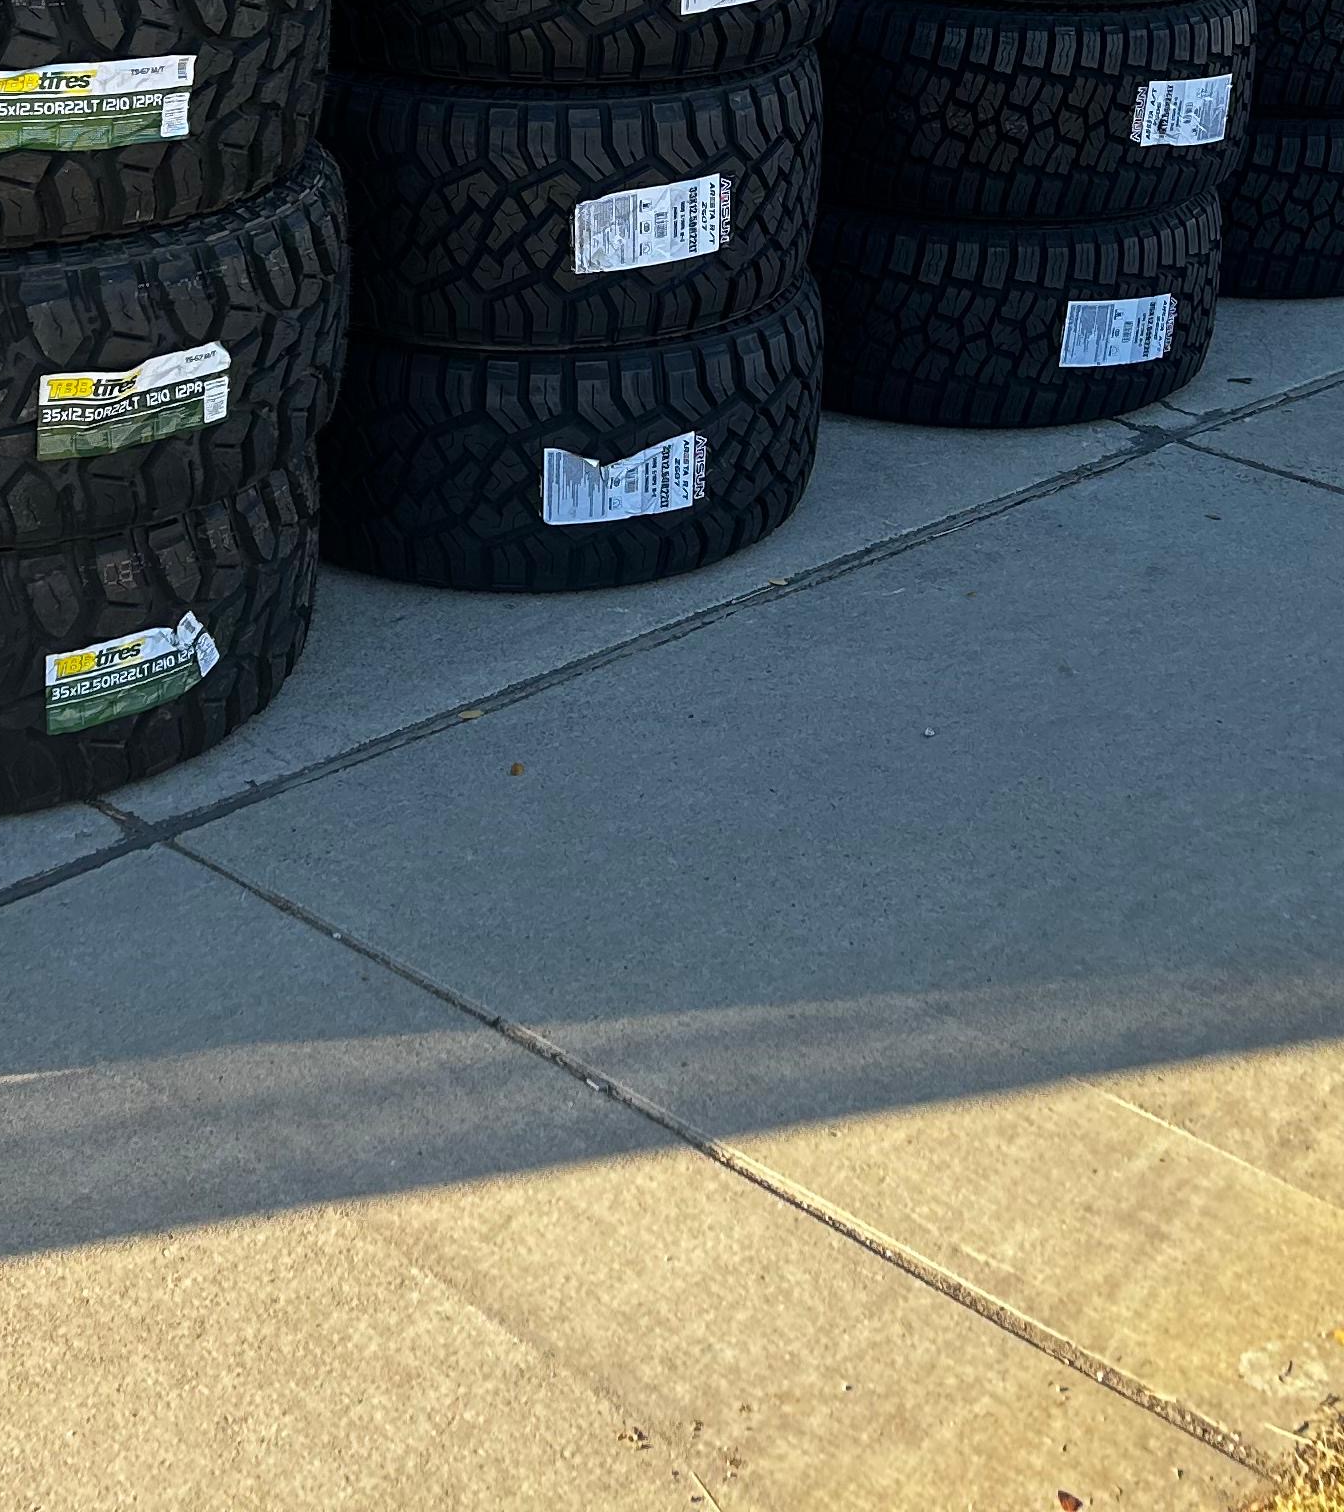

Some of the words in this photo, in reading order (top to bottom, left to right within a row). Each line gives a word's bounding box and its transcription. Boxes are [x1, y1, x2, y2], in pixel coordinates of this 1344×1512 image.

[132, 93, 162, 108] 12PR
[42, 396, 140, 423] 35x12.50R22LT
[175, 384, 202, 398] 12PR
[694, 435, 707, 500] ARISUN
[51, 664, 148, 700] 35x12.50R22LT
